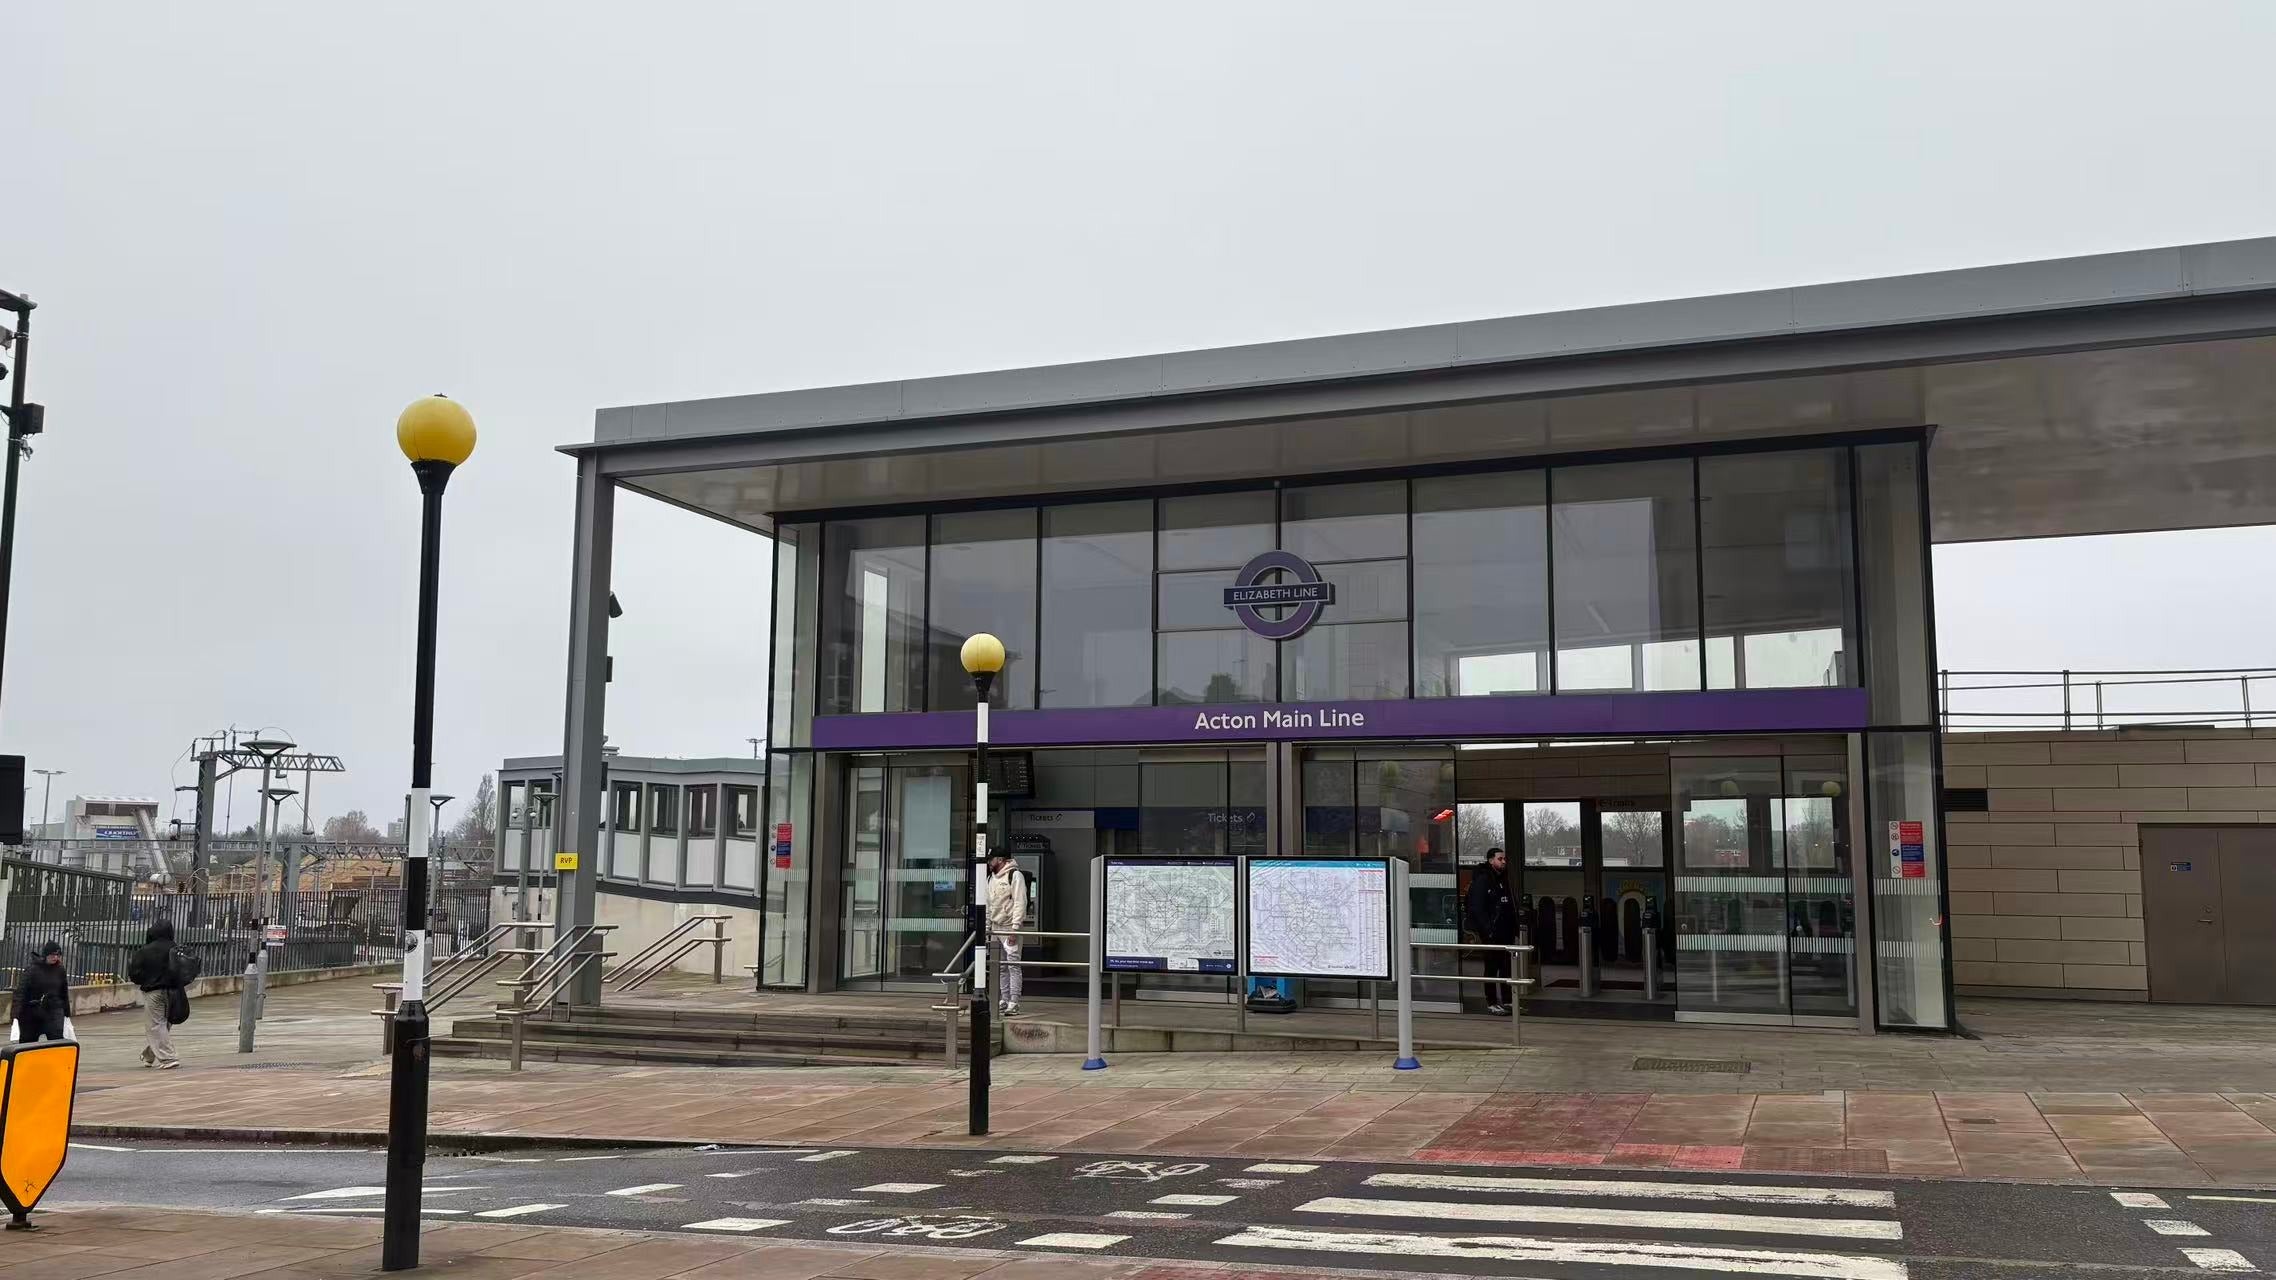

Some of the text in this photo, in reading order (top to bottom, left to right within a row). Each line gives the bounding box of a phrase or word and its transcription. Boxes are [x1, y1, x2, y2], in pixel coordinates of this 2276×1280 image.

[1233, 587, 1318, 601] ELIZABETH LINE
[1194, 709, 1365, 730] Acton Main Line
